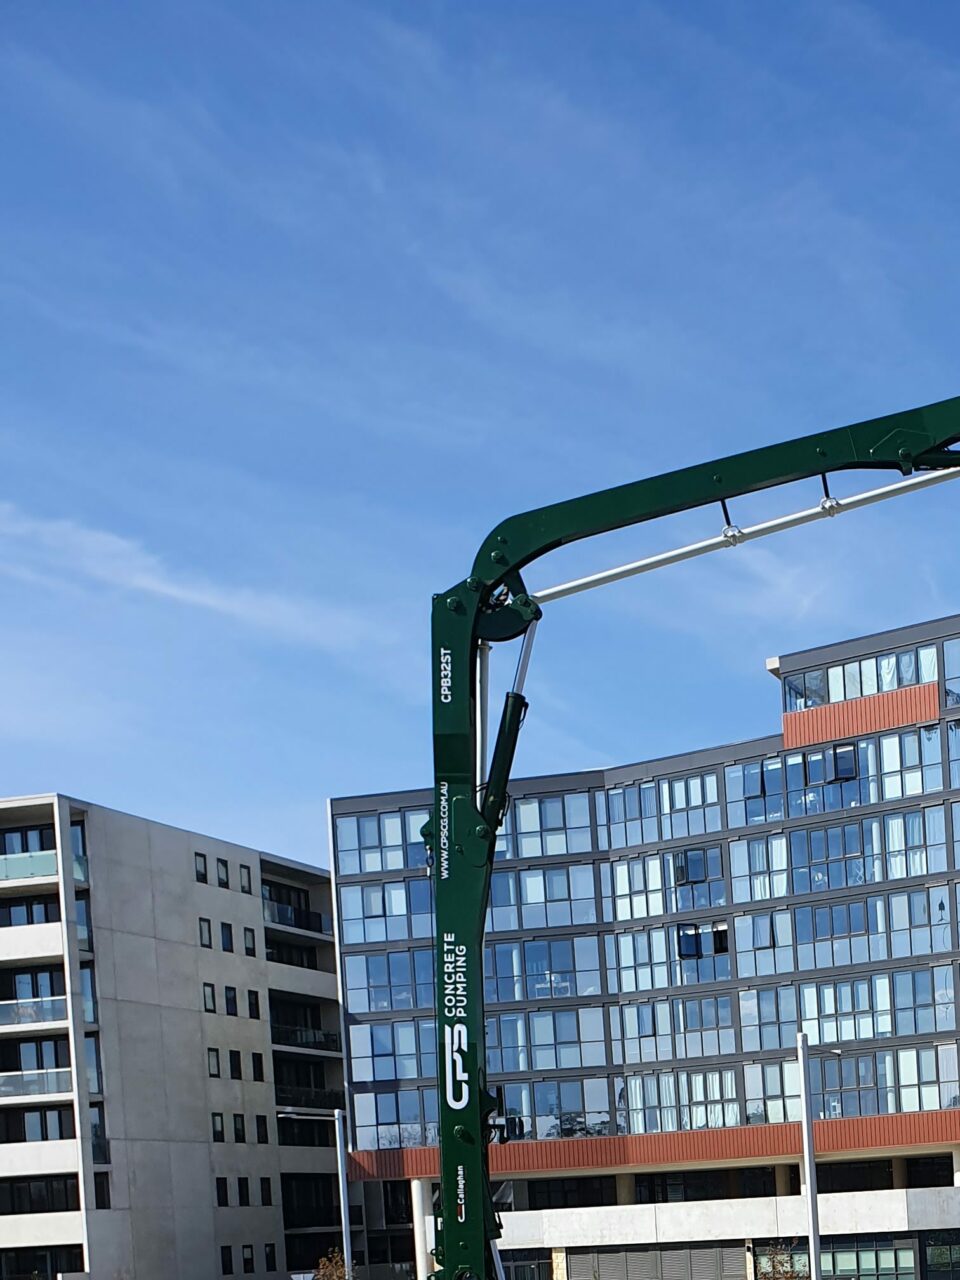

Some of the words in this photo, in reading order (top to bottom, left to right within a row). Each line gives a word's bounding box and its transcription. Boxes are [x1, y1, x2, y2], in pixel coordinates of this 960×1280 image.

[441, 647, 452, 703] CPB32ST
[440, 781, 449, 880] WWW.CPSCG.COM.AU
[444, 932, 455, 1017] CONCRETE
[456, 945, 467, 1017] PUMPING
[444, 1023, 469, 1110] CPS
[457, 1165, 465, 1204] Callaghan
